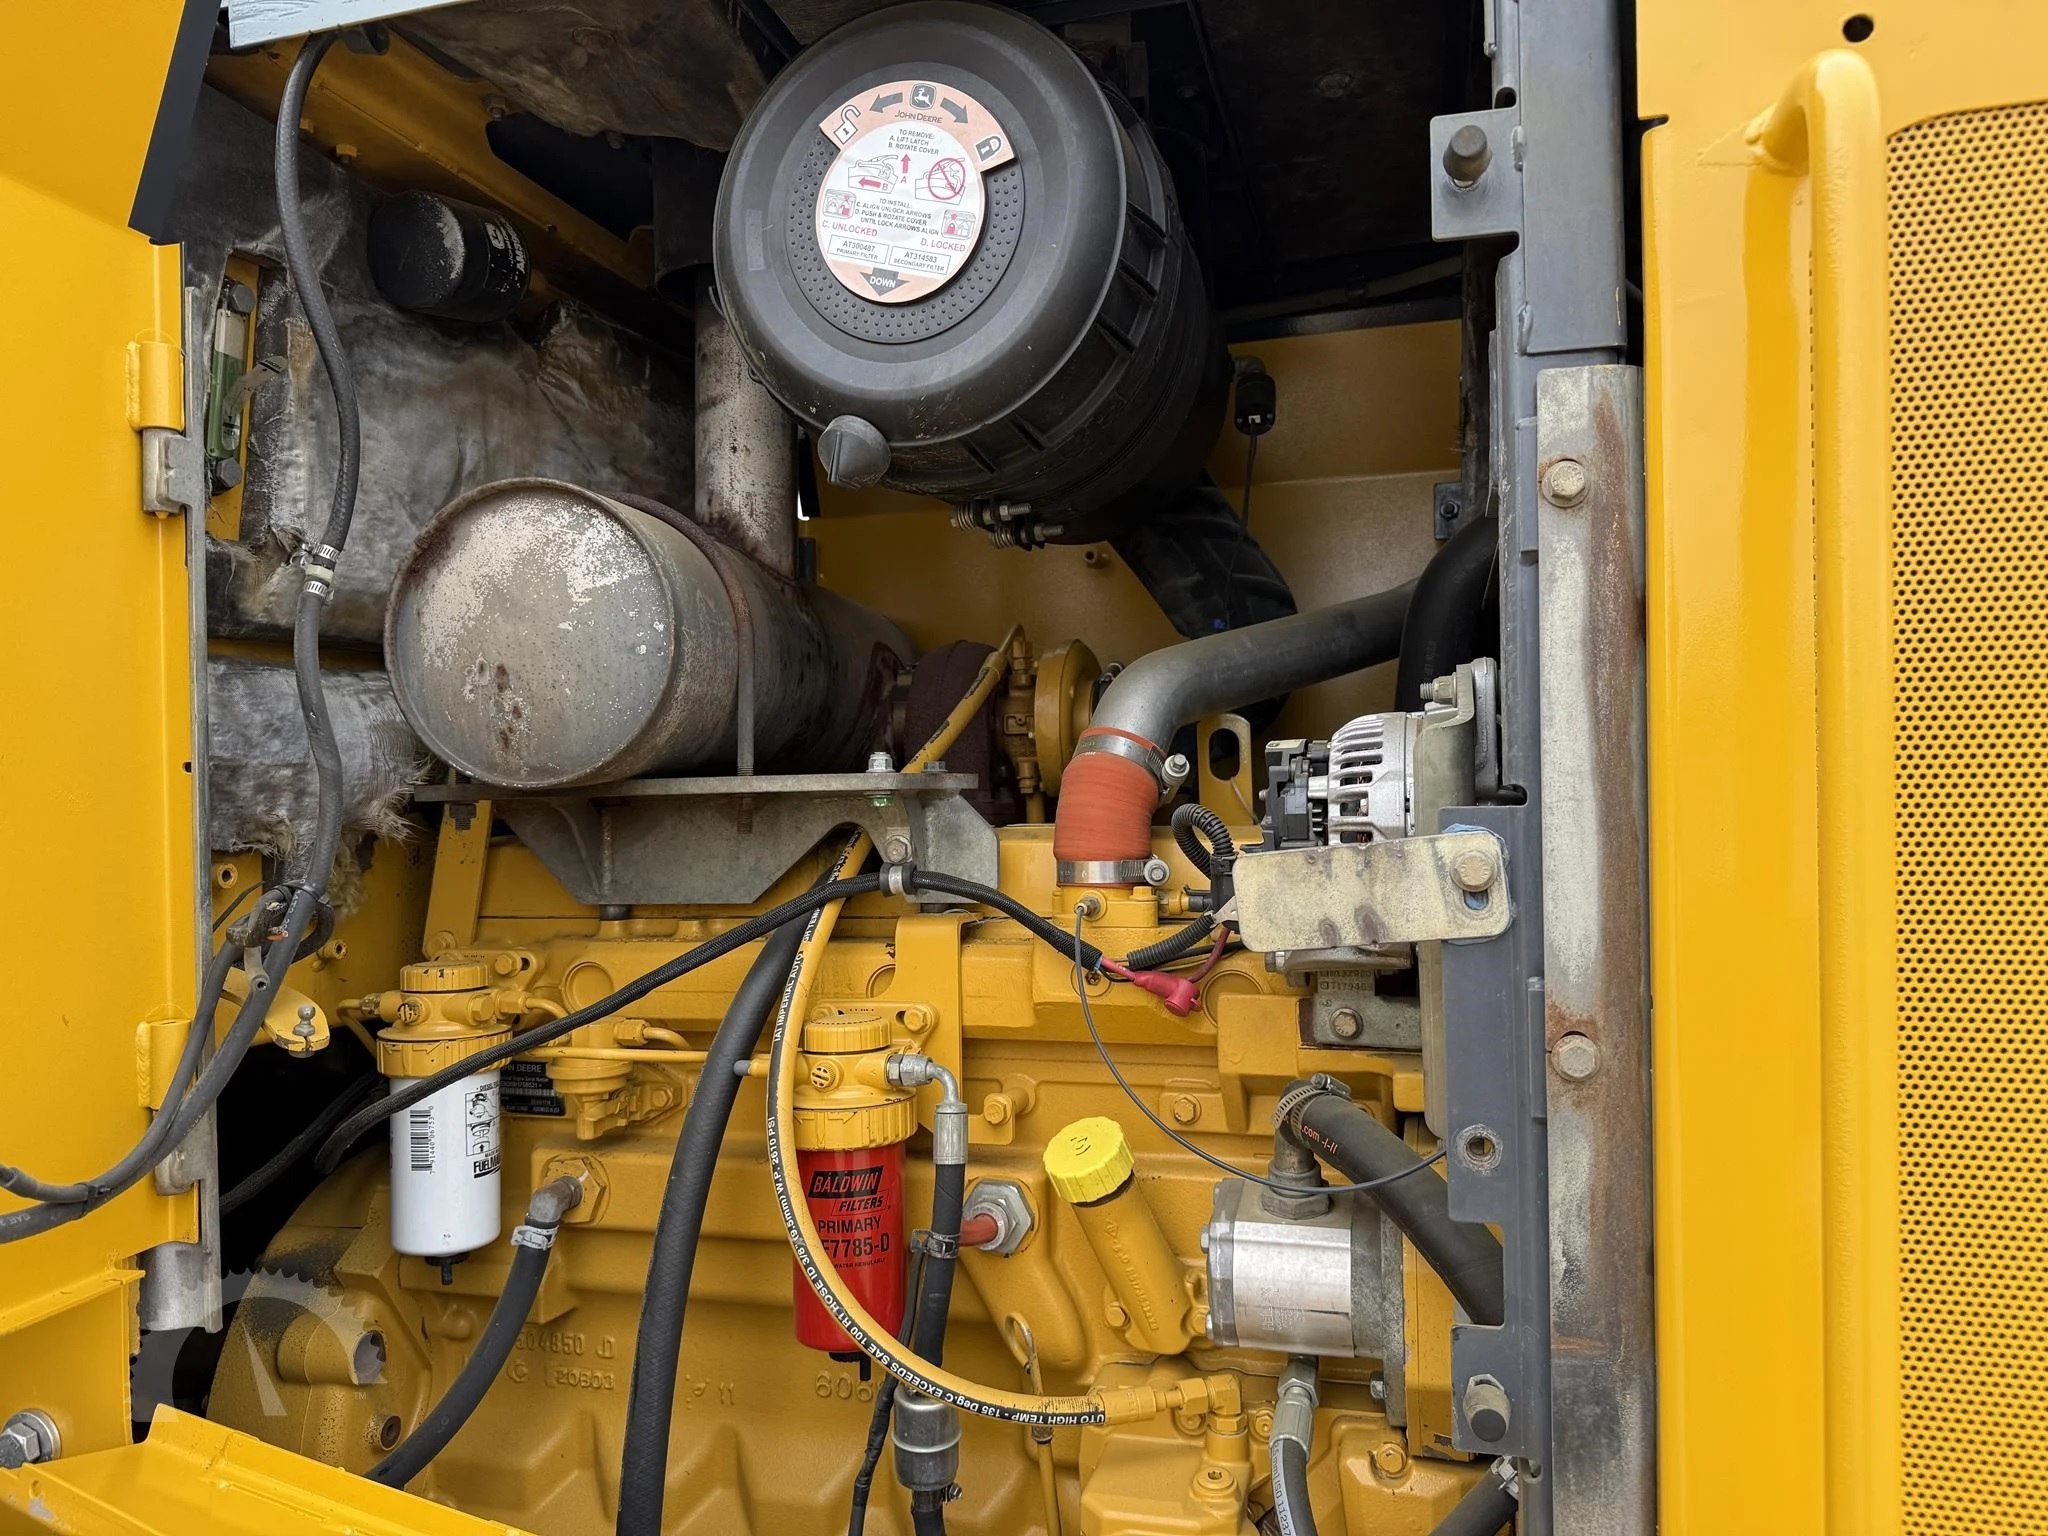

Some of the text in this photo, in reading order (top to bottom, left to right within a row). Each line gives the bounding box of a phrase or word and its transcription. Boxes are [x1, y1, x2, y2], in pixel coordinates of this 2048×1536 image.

[895, 110, 943, 123] JOHN DEERE
[908, 130, 935, 139] REMOVE:
[895, 143, 917, 151] ROTATE
[919, 146, 939, 155] COVER
[910, 138, 929, 146] LATCH
[882, 183, 888, 191] B
[901, 176, 907, 184] A
[888, 200, 912, 209] INSTALL:
[881, 206, 904, 214] UNLOCK
[905, 210, 932, 219] ARROWS
[883, 212, 905, 222] ROTATE
[906, 217, 927, 226] COVER
[832, 222, 878, 237] UNLOCKED
[861, 217, 876, 225] UNTIL
[894, 222, 920, 232] ARROWS
[921, 228, 939, 236] ALIGN
[920, 238, 965, 252] D. LOCKED
[836, 248, 878, 260] PRIMARY FILTER
[904, 252, 938, 263] AT314583
[893, 258, 945, 272] SECONDARY FILTER
[869, 276, 896, 288] DOWN
[778, 979, 795, 1026] IMPERIAL
[790, 953, 804, 980] AUTO
[516, 1064, 543, 1073] DEERE
[767, 1116, 776, 1137] PSI
[769, 1138, 779, 1165] 2610
[773, 1167, 784, 1193] W.P.
[813, 1171, 878, 1193] BALDWIN
[839, 1196, 884, 1212] FILTERS
[818, 1215, 881, 1234] PRIMARY
[806, 1266, 818, 1280] ID
[814, 1279, 840, 1315] HOSE
[838, 1312, 852, 1329] R1
[850, 1326, 867, 1345] 100
[867, 1343, 891, 1365] SAE
[890, 1361, 943, 1398] EXCEEDS
[944, 1392, 979, 1413] Deg.C
[981, 1405, 1001, 1418] 135
[1011, 1412, 1044, 1425] TEMP
[1048, 1415, 1077, 1425] HIGH
[1273, 1479, 1283, 1499] ISO
